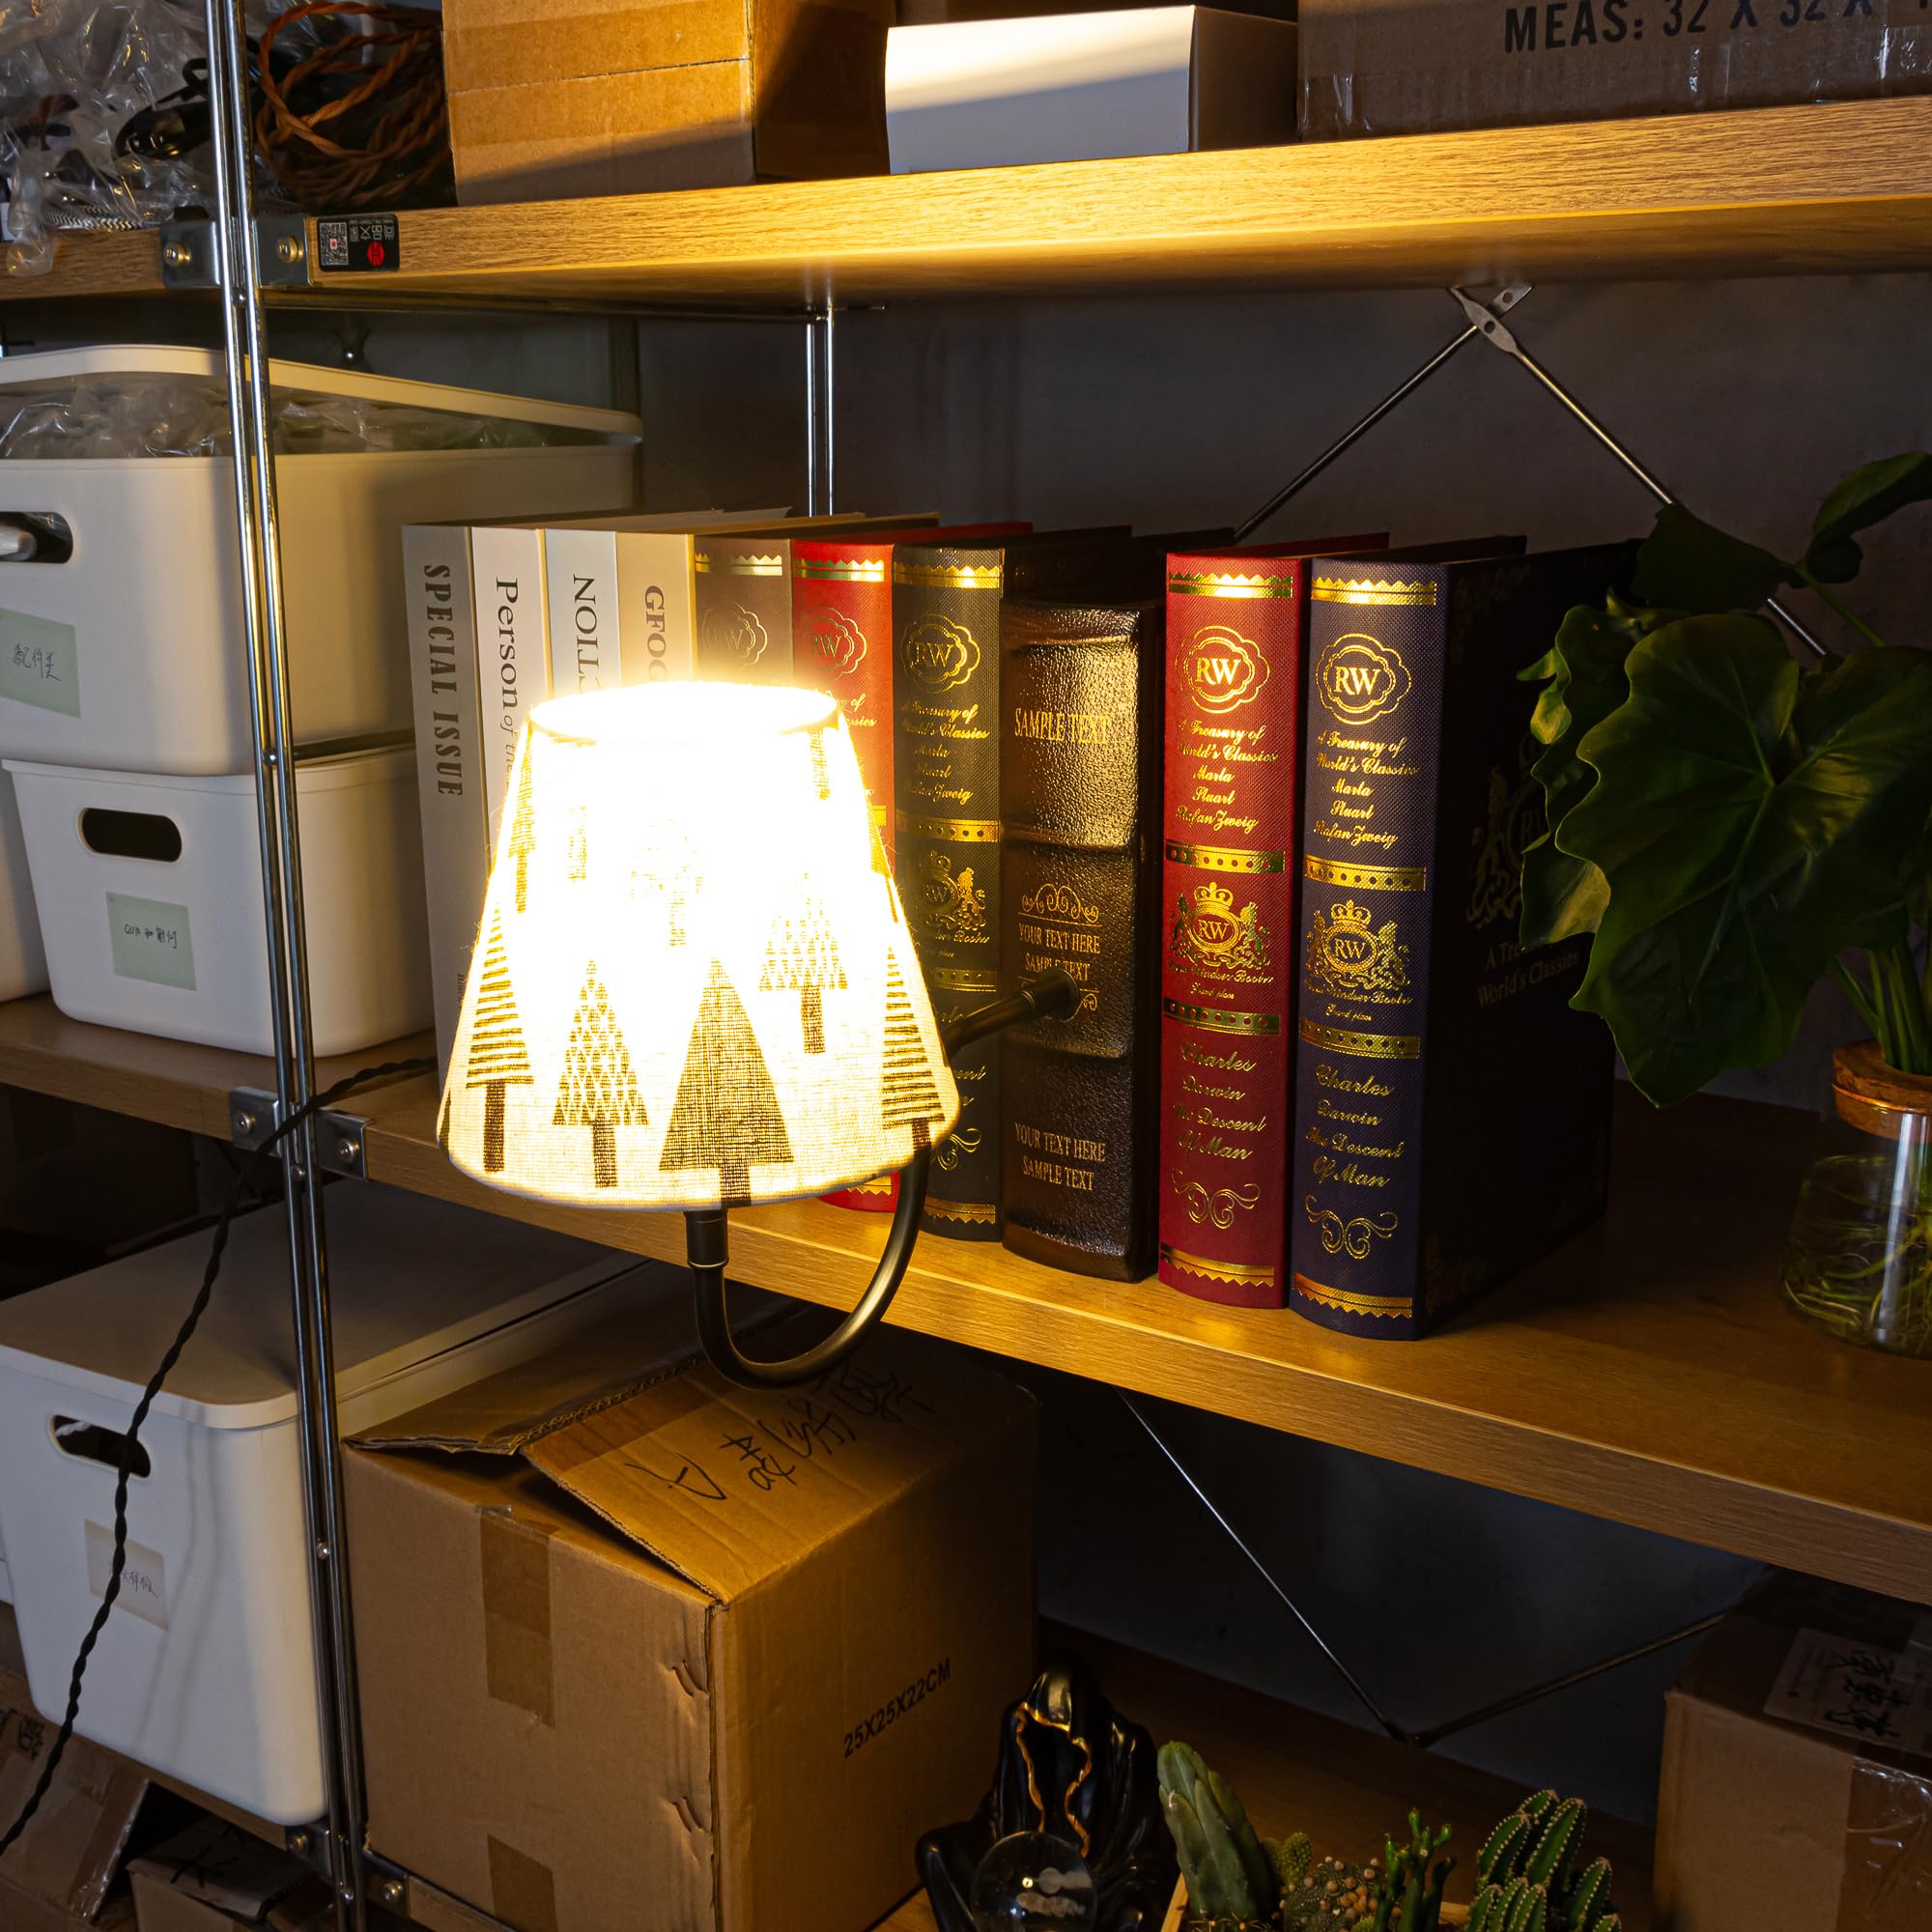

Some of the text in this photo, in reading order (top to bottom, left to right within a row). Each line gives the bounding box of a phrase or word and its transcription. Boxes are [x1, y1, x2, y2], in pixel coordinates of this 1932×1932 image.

[1504, 0, 1643, 54] MEAS:
[496, 576, 519, 709] Person
[423, 563, 464, 796] SPECIAL ISSUE
[1196, 658, 1241, 685] RW
[1335, 665, 1382, 696] RW
[961, 703, 979, 724] of
[1014, 707, 1110, 744] SAMPLE TEXT
[1247, 724, 1267, 747] of
[1326, 730, 1388, 758] Treasury
[1387, 735, 1407, 758] of
[1018, 923, 1101, 954] YOUR TEXT HERE
[1196, 922, 1230, 941] RW
[1334, 938, 1367, 959] RW
[1180, 1042, 1257, 1072] Charles
[1316, 1064, 1395, 1096] Charles
[1197, 1107, 1267, 1131] Descent
[1317, 1098, 1383, 1125] Darwin
[1014, 1122, 1106, 1164] YOUR TEXT HERE
[1199, 1135, 1254, 1160] Man
[1331, 1132, 1406, 1158] Descent
[1022, 1155, 1095, 1191] SAMPLE TEXT
[1333, 1162, 1391, 1187] Man
[842, 1657, 952, 1760] 25X25X22CM
